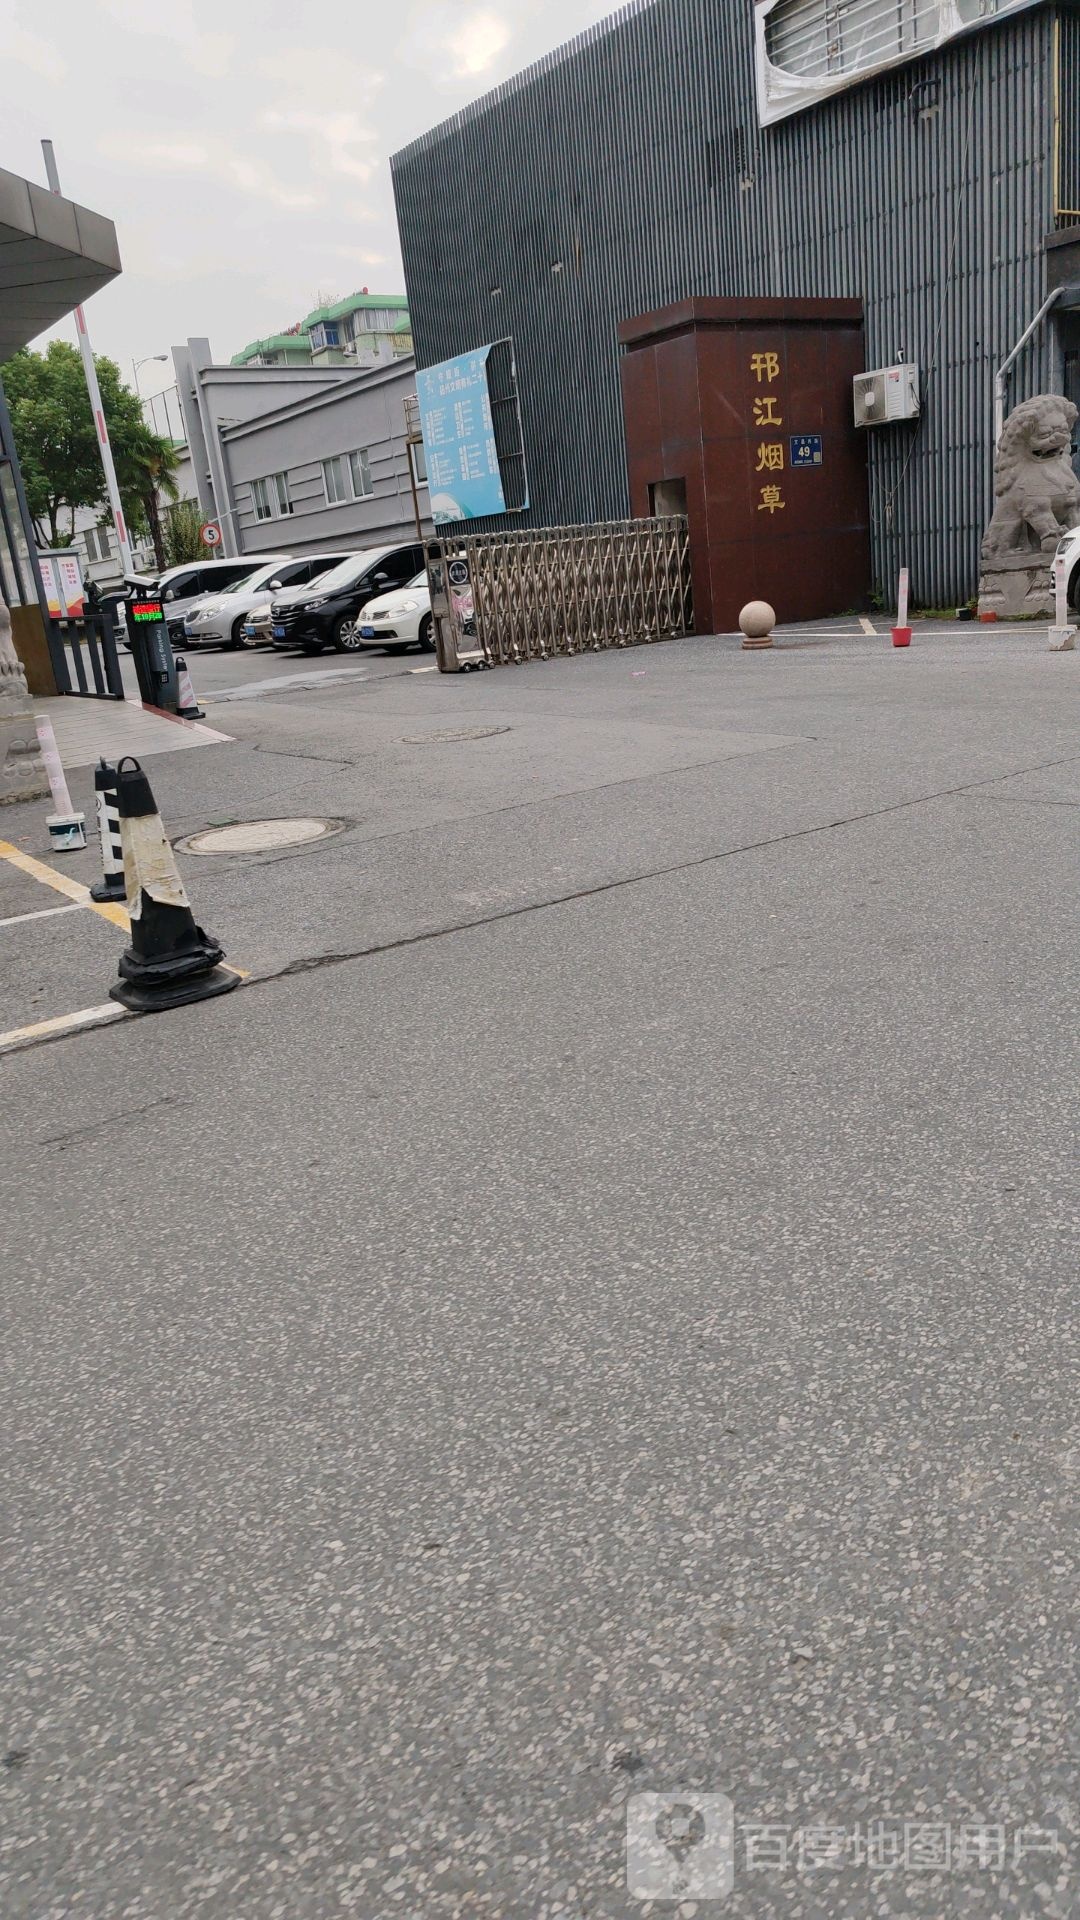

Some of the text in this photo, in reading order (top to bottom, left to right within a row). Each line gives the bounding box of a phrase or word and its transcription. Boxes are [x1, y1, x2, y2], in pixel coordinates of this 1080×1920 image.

[750, 352, 786, 514] 邗江烟草
[798, 446, 810, 457] 49
[208, 530, 215, 540] 5
[155, 629, 164, 653] Parking
